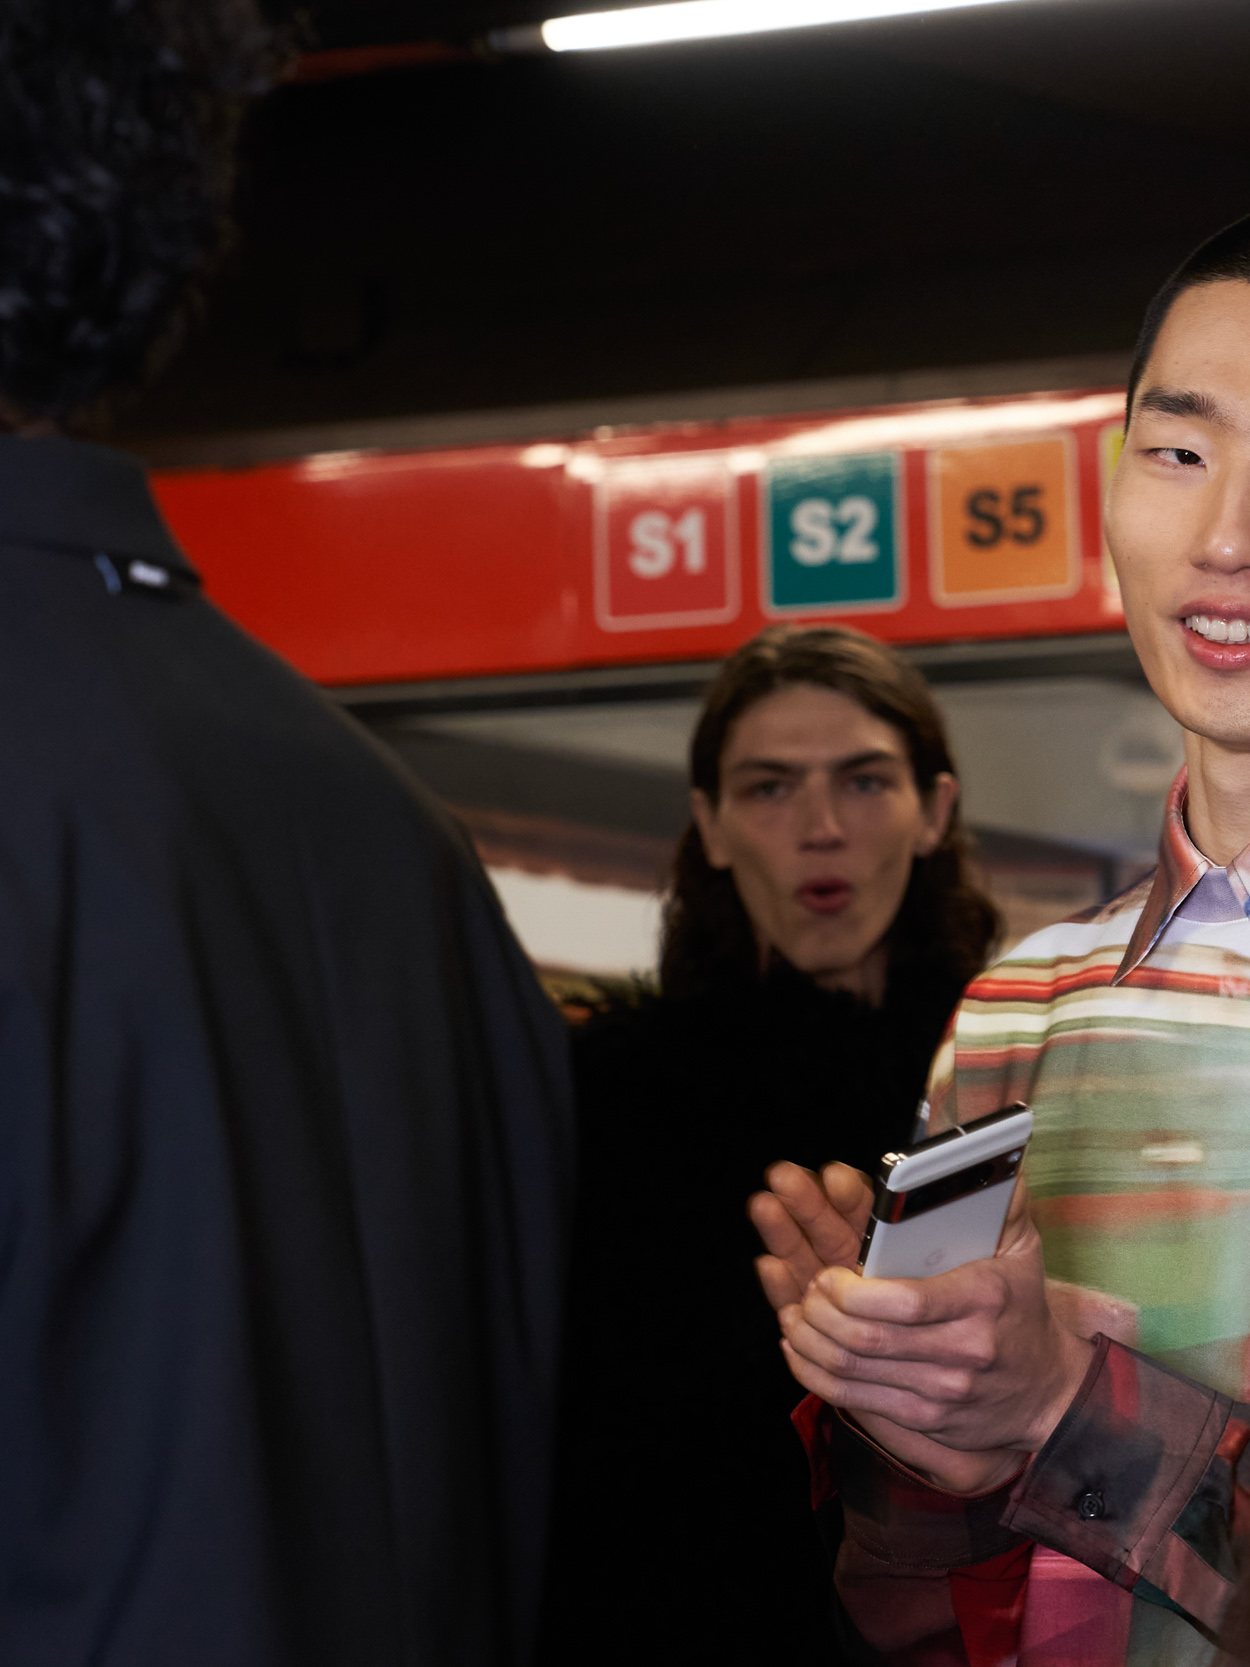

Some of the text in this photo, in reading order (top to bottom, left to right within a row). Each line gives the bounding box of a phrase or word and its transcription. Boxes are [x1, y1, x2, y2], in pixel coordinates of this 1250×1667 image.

[628, 508, 705, 578] S1
[791, 497, 879, 566] S2
[966, 486, 1046, 549] S5
